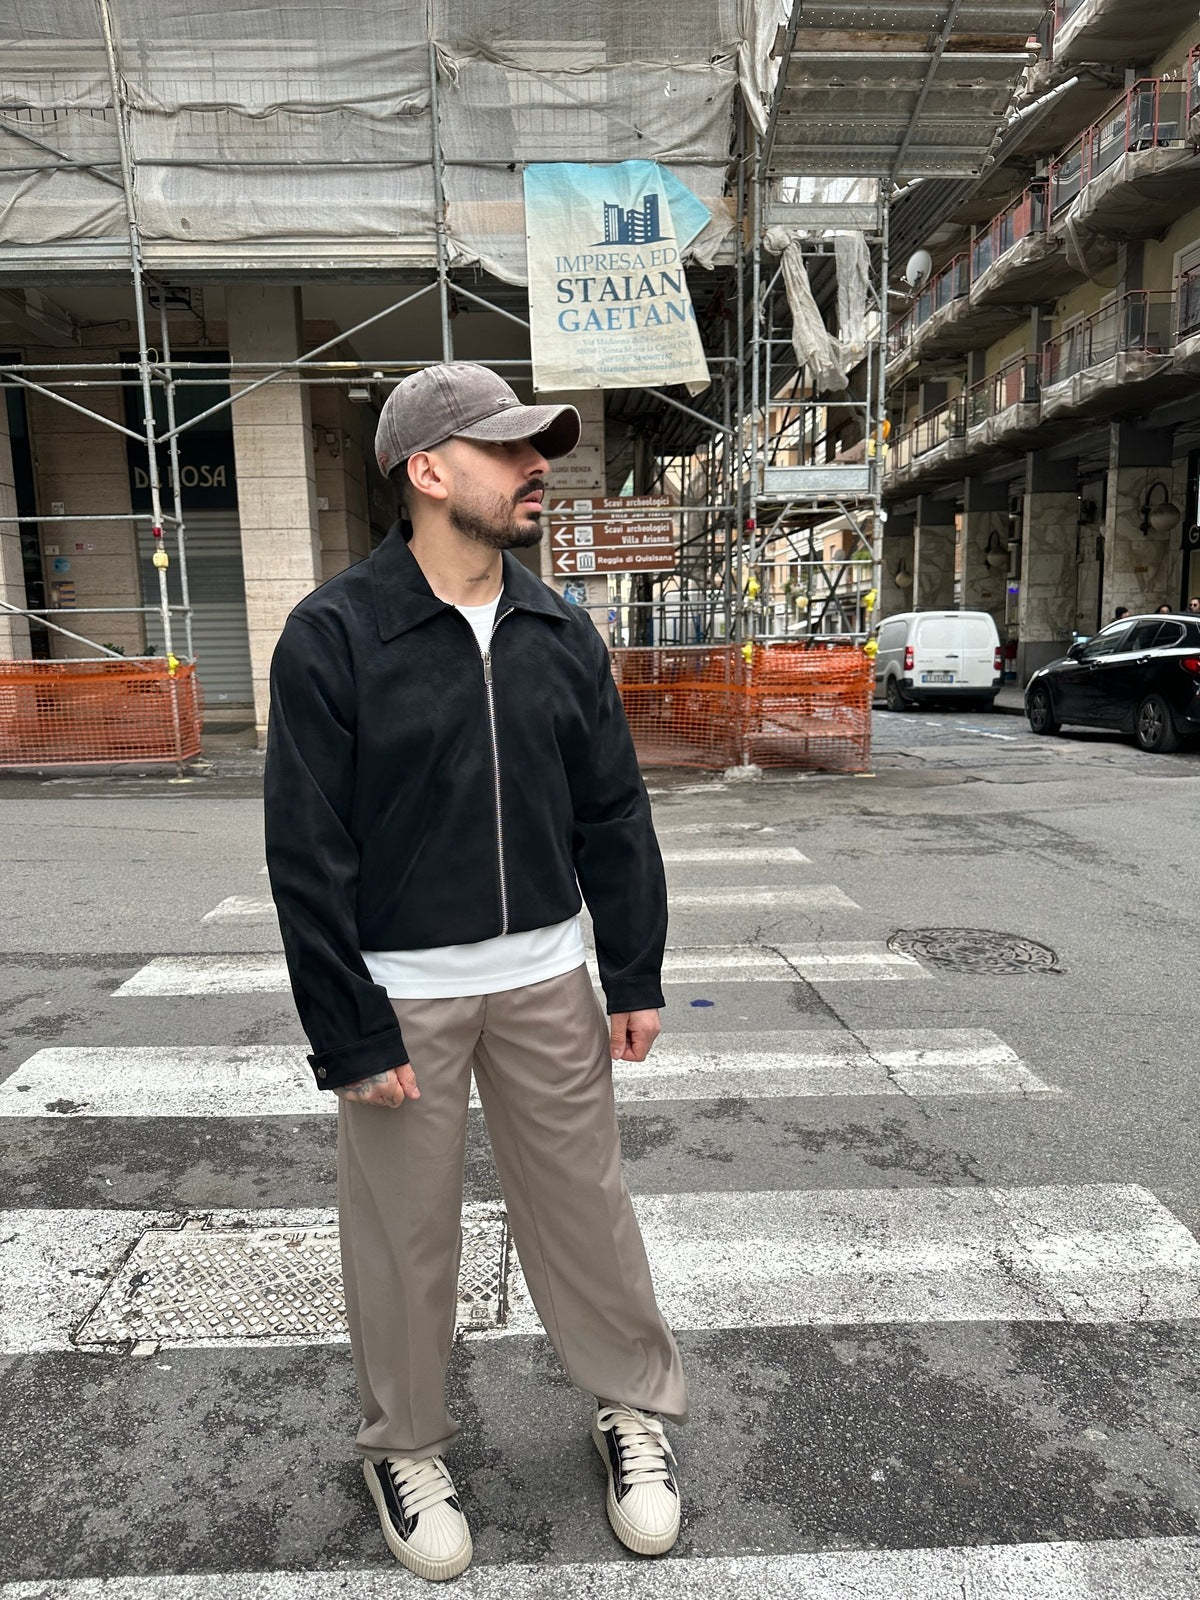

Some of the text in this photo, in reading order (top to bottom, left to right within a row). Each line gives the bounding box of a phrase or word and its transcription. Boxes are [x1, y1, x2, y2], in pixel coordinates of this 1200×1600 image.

[556, 252, 647, 273] IMPRESA
[557, 269, 683, 303] STAIAN
[134, 466, 162, 488] D
[603, 496, 670, 507] Scavi archeologici
[604, 523, 670, 534] Scavi archeologici
[621, 535, 670, 544] Villa Arianna
[597, 556, 624, 565] Reggia
[635, 554, 673, 563] Quisisana
